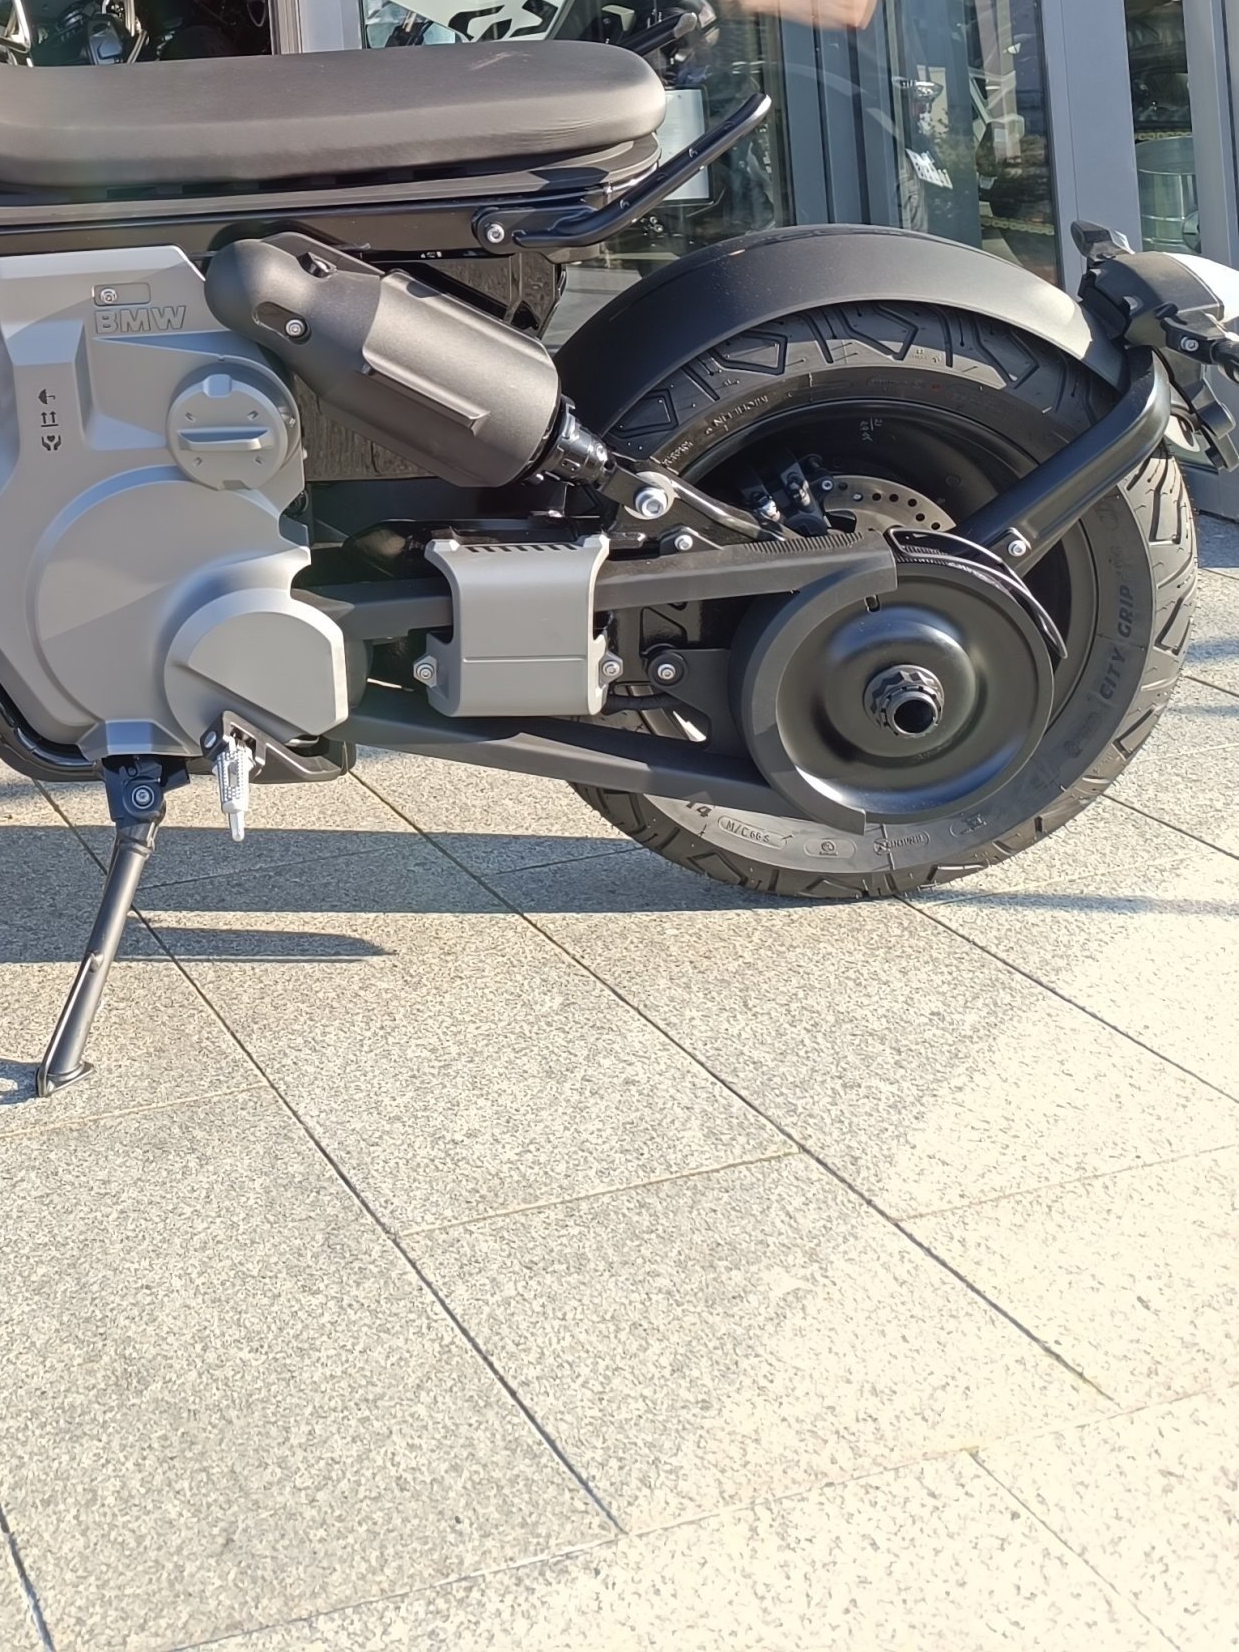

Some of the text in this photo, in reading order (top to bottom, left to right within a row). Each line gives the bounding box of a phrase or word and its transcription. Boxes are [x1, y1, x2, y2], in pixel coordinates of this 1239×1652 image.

[94, 304, 186, 334] BMW
[1099, 584, 1136, 700] CITY GRIP
